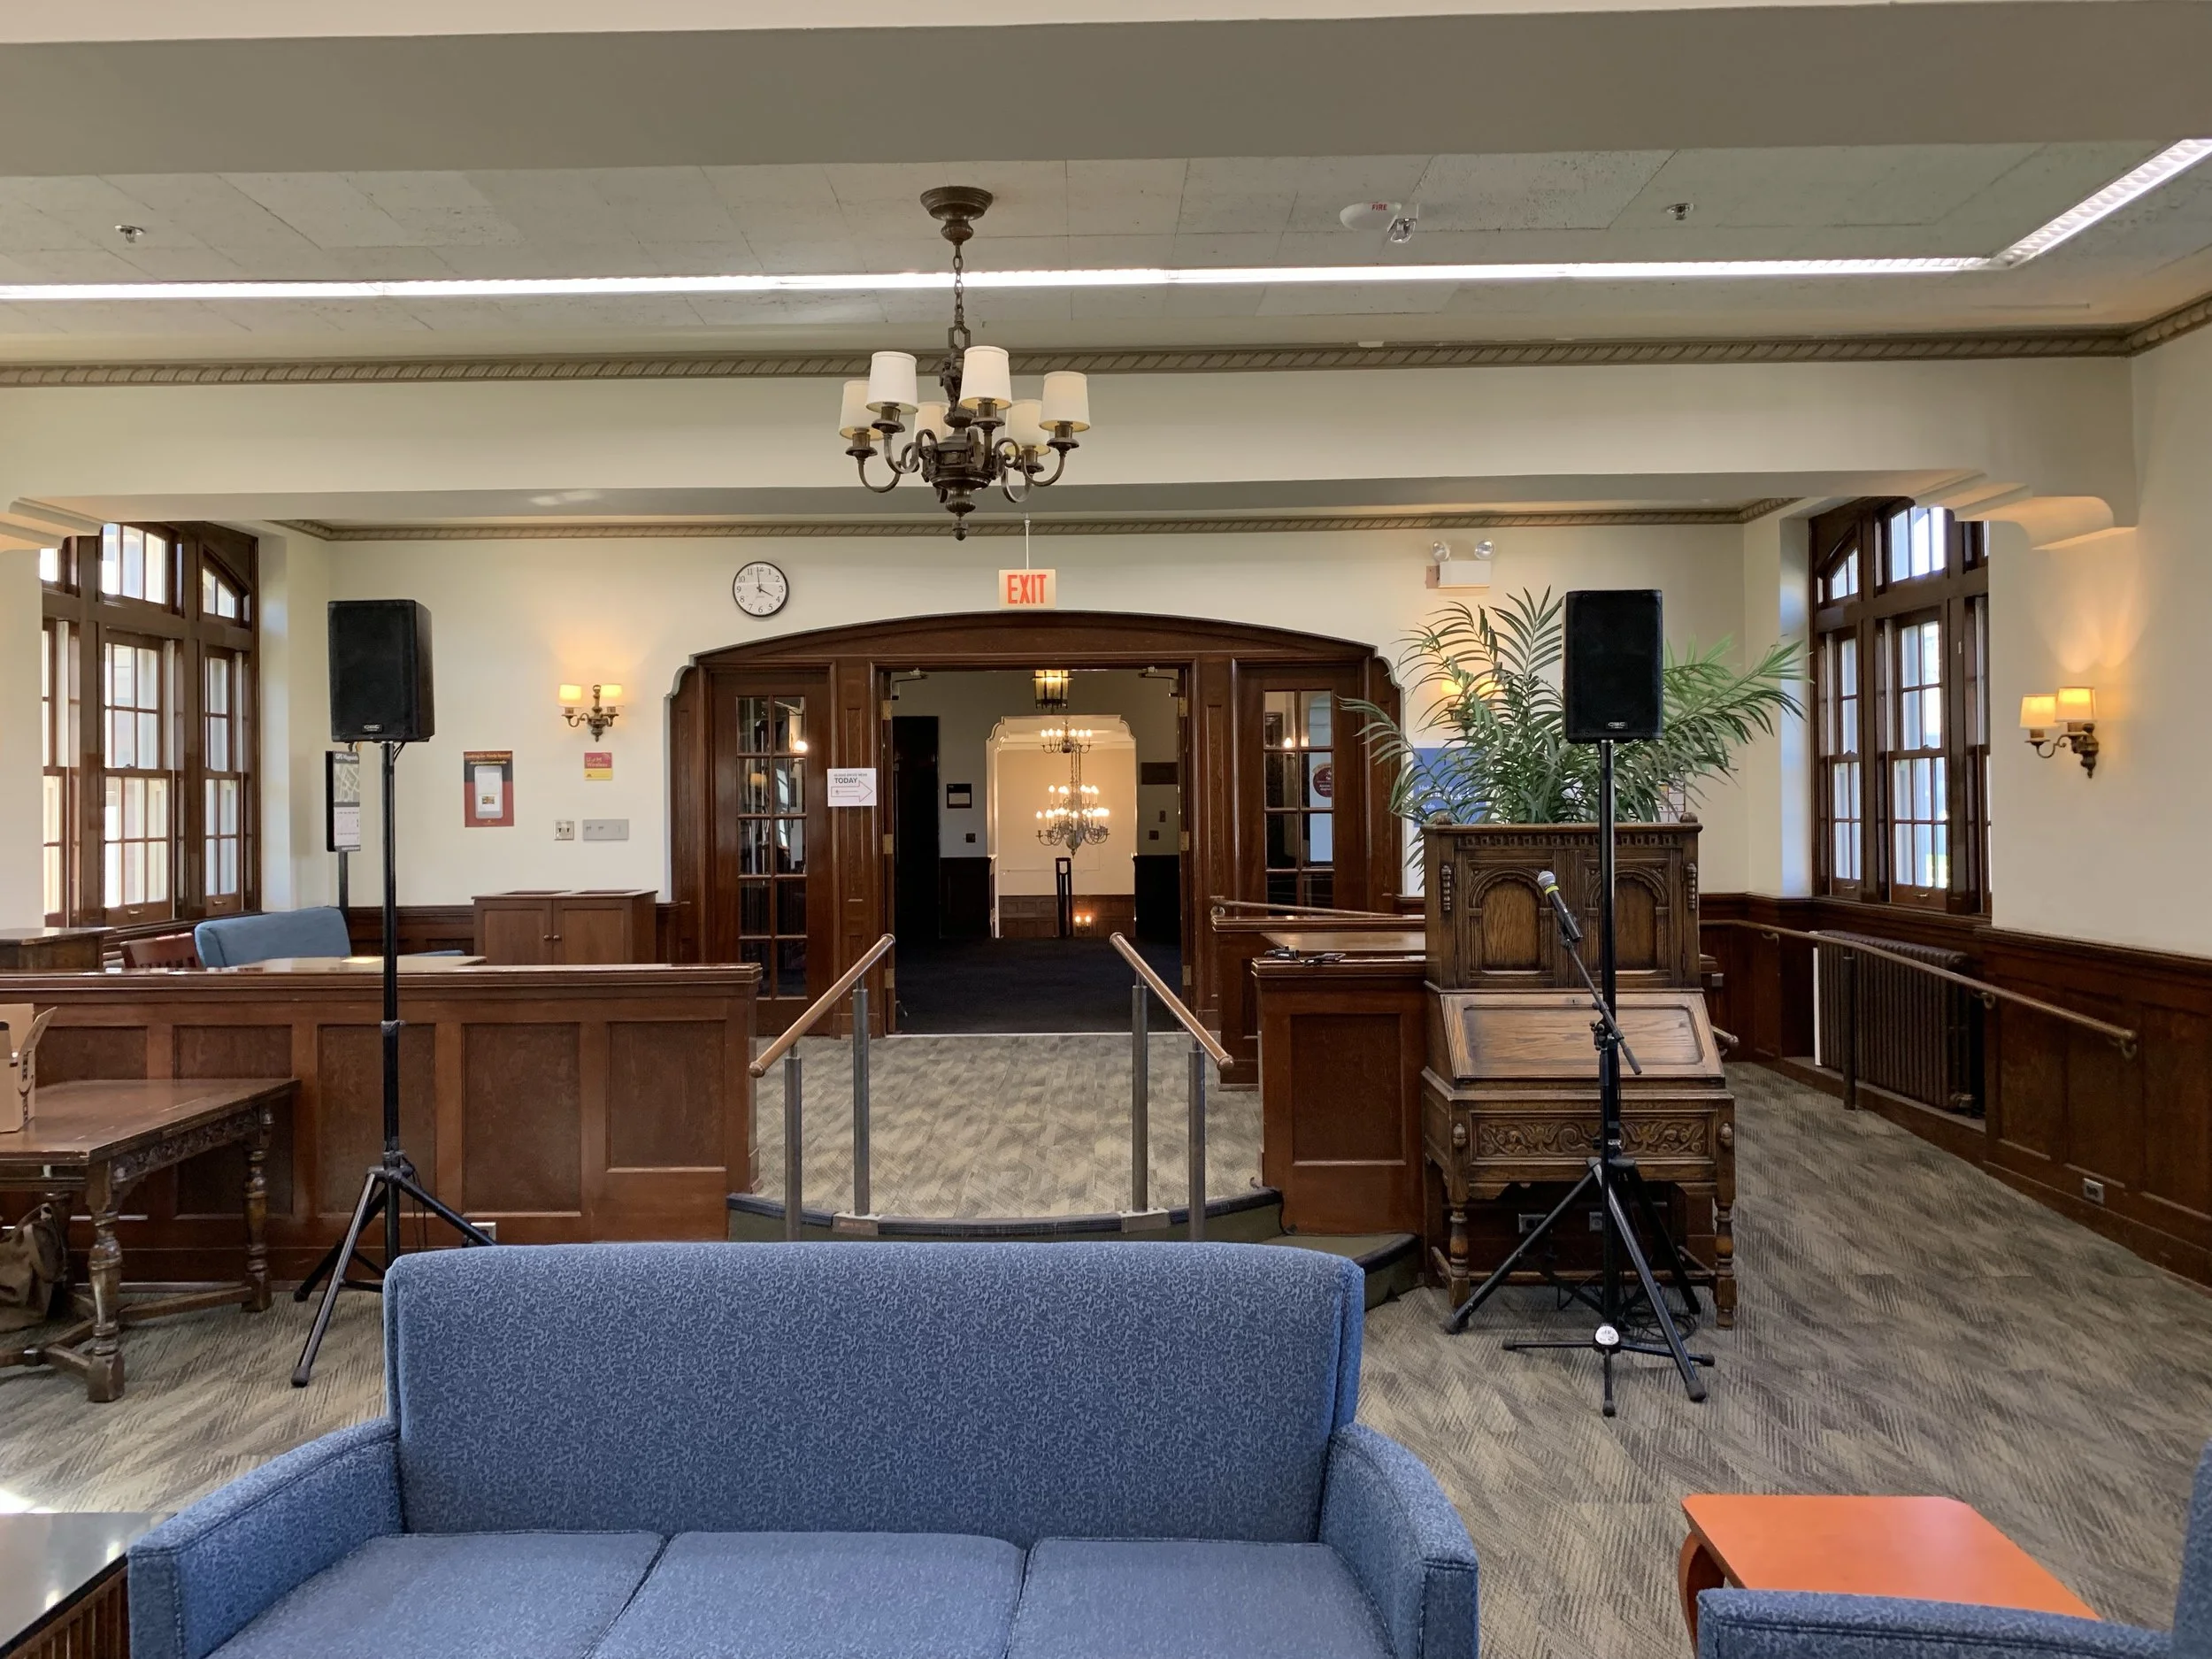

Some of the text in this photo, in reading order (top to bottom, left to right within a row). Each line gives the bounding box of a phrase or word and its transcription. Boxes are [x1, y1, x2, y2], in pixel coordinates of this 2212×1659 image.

[736, 585, 741, 594] 9
[779, 585, 784, 594] 3
[1007, 574, 1047, 604] EXIT
